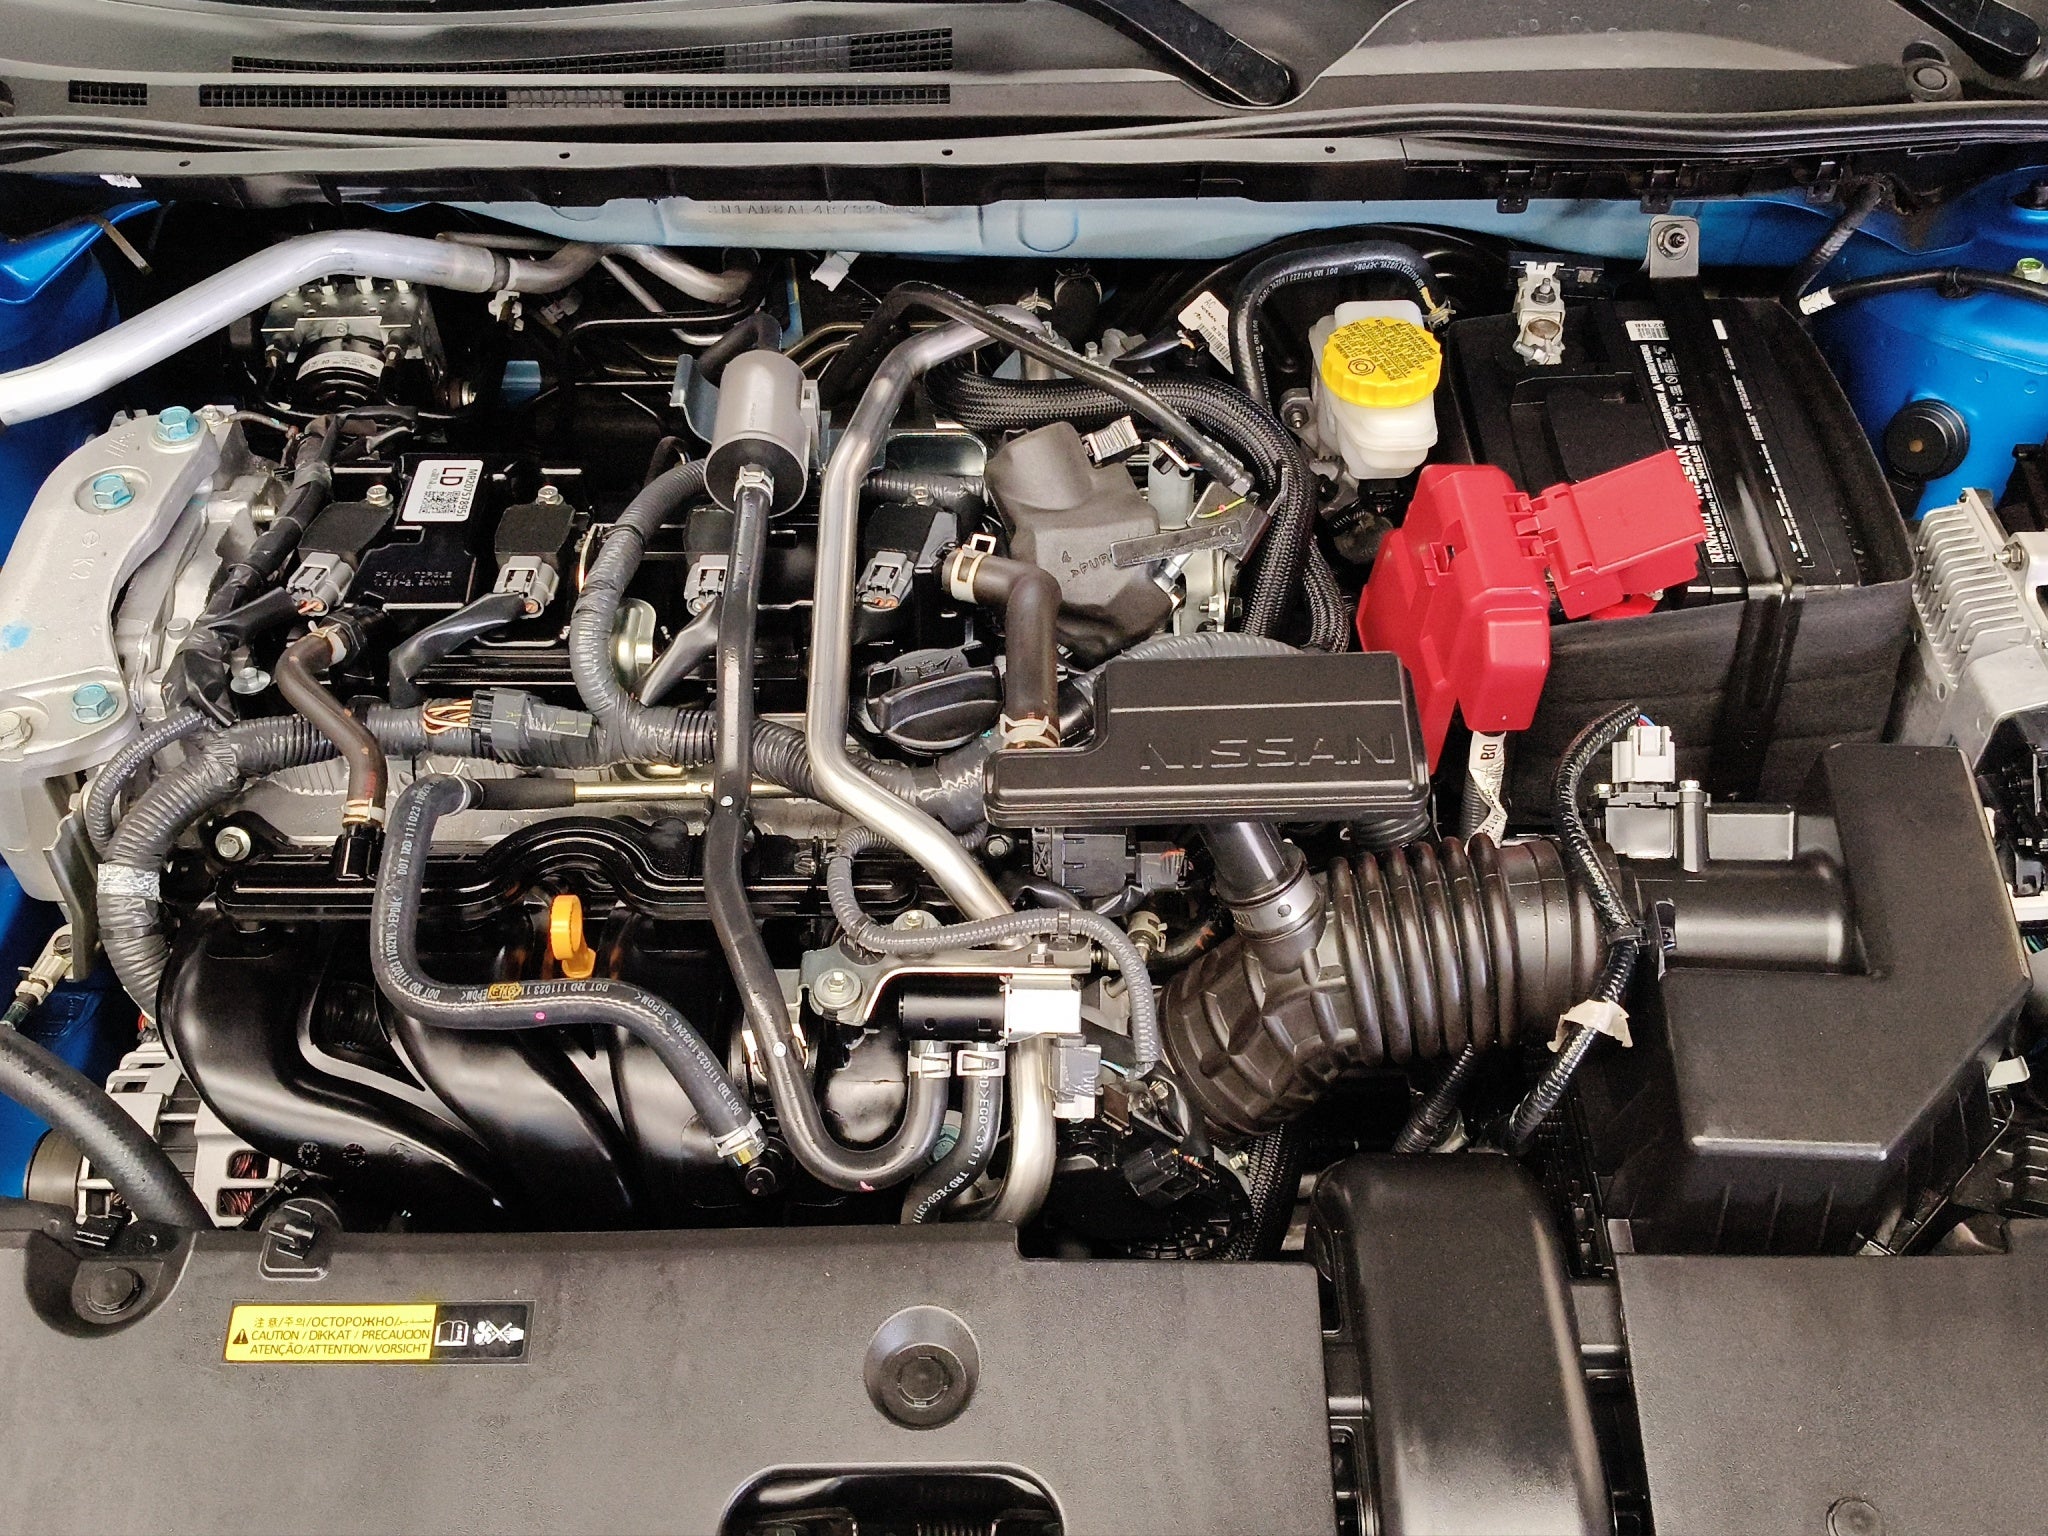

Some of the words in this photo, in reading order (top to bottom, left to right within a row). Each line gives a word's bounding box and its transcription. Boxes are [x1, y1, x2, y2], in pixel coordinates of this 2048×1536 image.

[440, 467, 467, 486] LD
[1140, 735, 1396, 770] NISSAN
[397, 857, 409, 875] DOT
[588, 982, 608, 991] DOT
[726, 1096, 742, 1115] DOT
[251, 1330, 299, 1340] CAUTION
